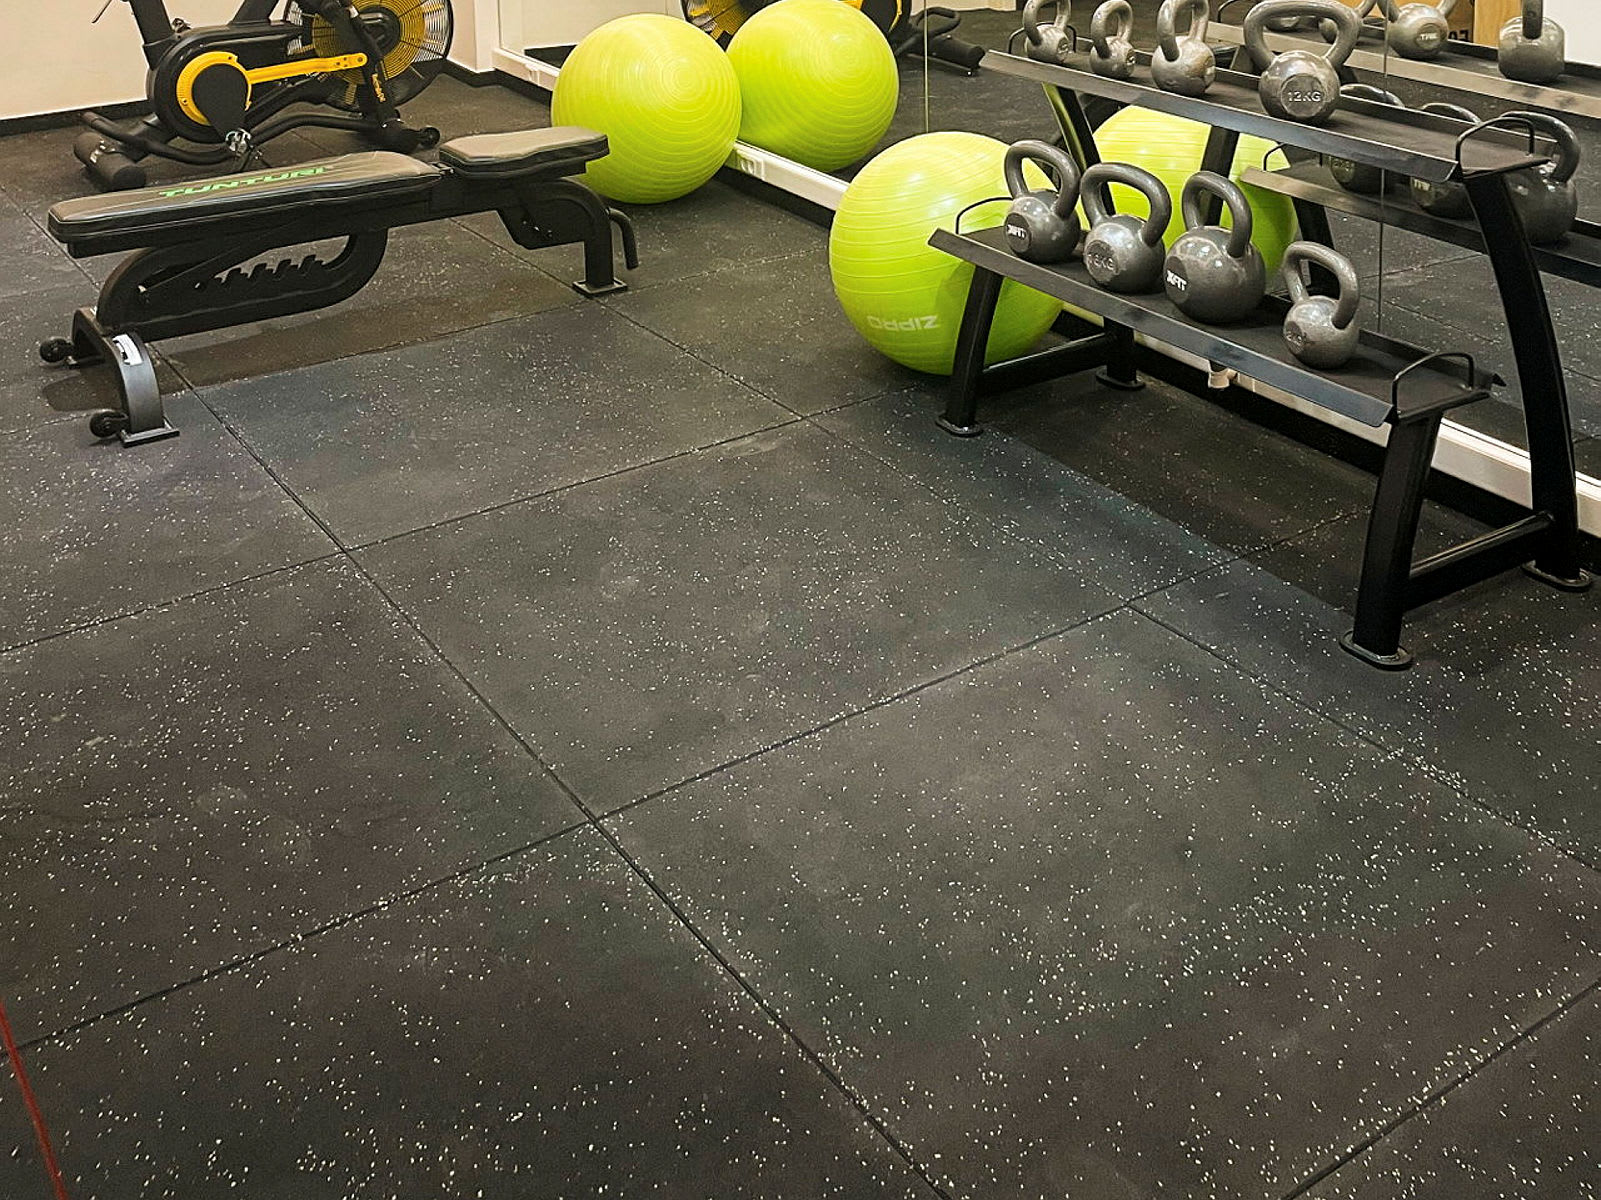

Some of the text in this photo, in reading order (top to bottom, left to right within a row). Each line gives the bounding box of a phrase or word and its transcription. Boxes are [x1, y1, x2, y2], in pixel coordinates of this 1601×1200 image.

[1287, 91, 1321, 102] 12KG
[159, 167, 327, 197] TUNTURI
[866, 315, 940, 331] ZIPRO
